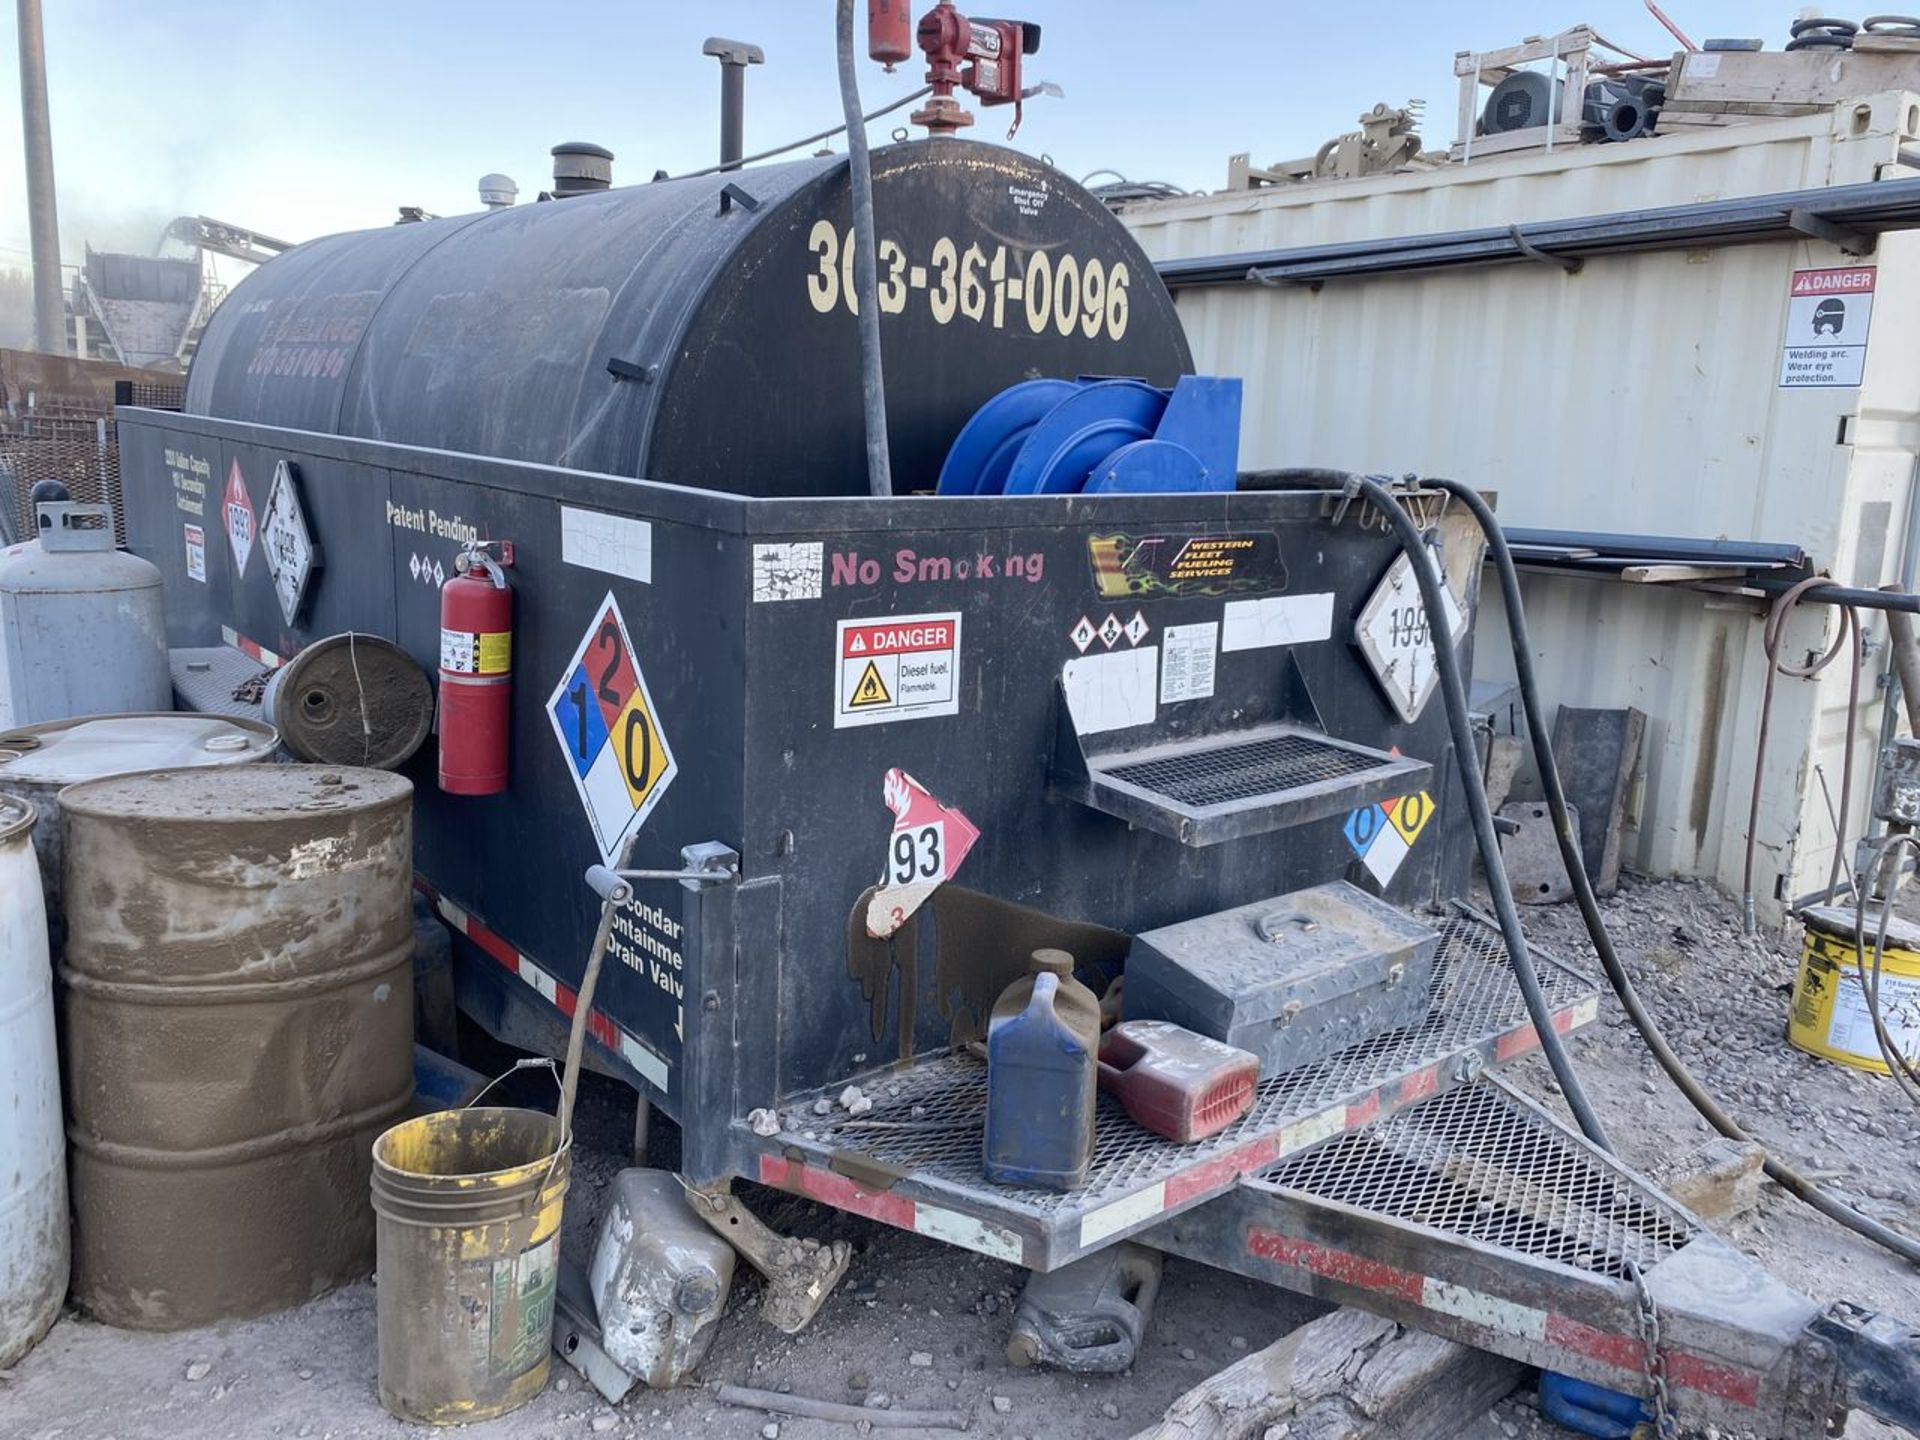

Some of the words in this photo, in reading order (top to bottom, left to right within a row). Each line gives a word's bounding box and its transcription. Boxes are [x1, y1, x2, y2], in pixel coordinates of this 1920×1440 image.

[1009, 186, 1048, 201] Emergency
[1020, 206, 1038, 216] Valve
[1813, 273, 1871, 289] DANGER
[1789, 350, 1828, 360] Welding
[1830, 351, 1849, 359] arc.
[1787, 362, 1813, 371] Wear
[1815, 363, 1833, 372] eye
[1785, 374, 1837, 384] protection.
[229, 506, 251, 541] 1993
[386, 500, 426, 532] Patent
[428, 509, 478, 543] Pending
[1183, 550, 1223, 559] FLEET
[1190, 540, 1254, 550] WESTERN
[831, 552, 880, 586] No
[892, 549, 1044, 583] Smokng
[1168, 567, 1232, 579] SERVICES
[1177, 559, 1235, 569] FUELING
[1390, 606, 1431, 648] 199
[873, 627, 947, 650] DANGER
[600, 622, 622, 707] 2
[900, 664, 929, 679] Diesel
[929, 661, 949, 675] fuel.
[900, 681, 936, 694] Flammable.
[570, 682, 588, 760] 1
[625, 708, 650, 792] 0
[1400, 794, 1424, 833] 0
[1354, 804, 1376, 845] 0
[625, 897, 684, 940] condar
[606, 932, 645, 975] Drain
[650, 959, 684, 1000] Valv
